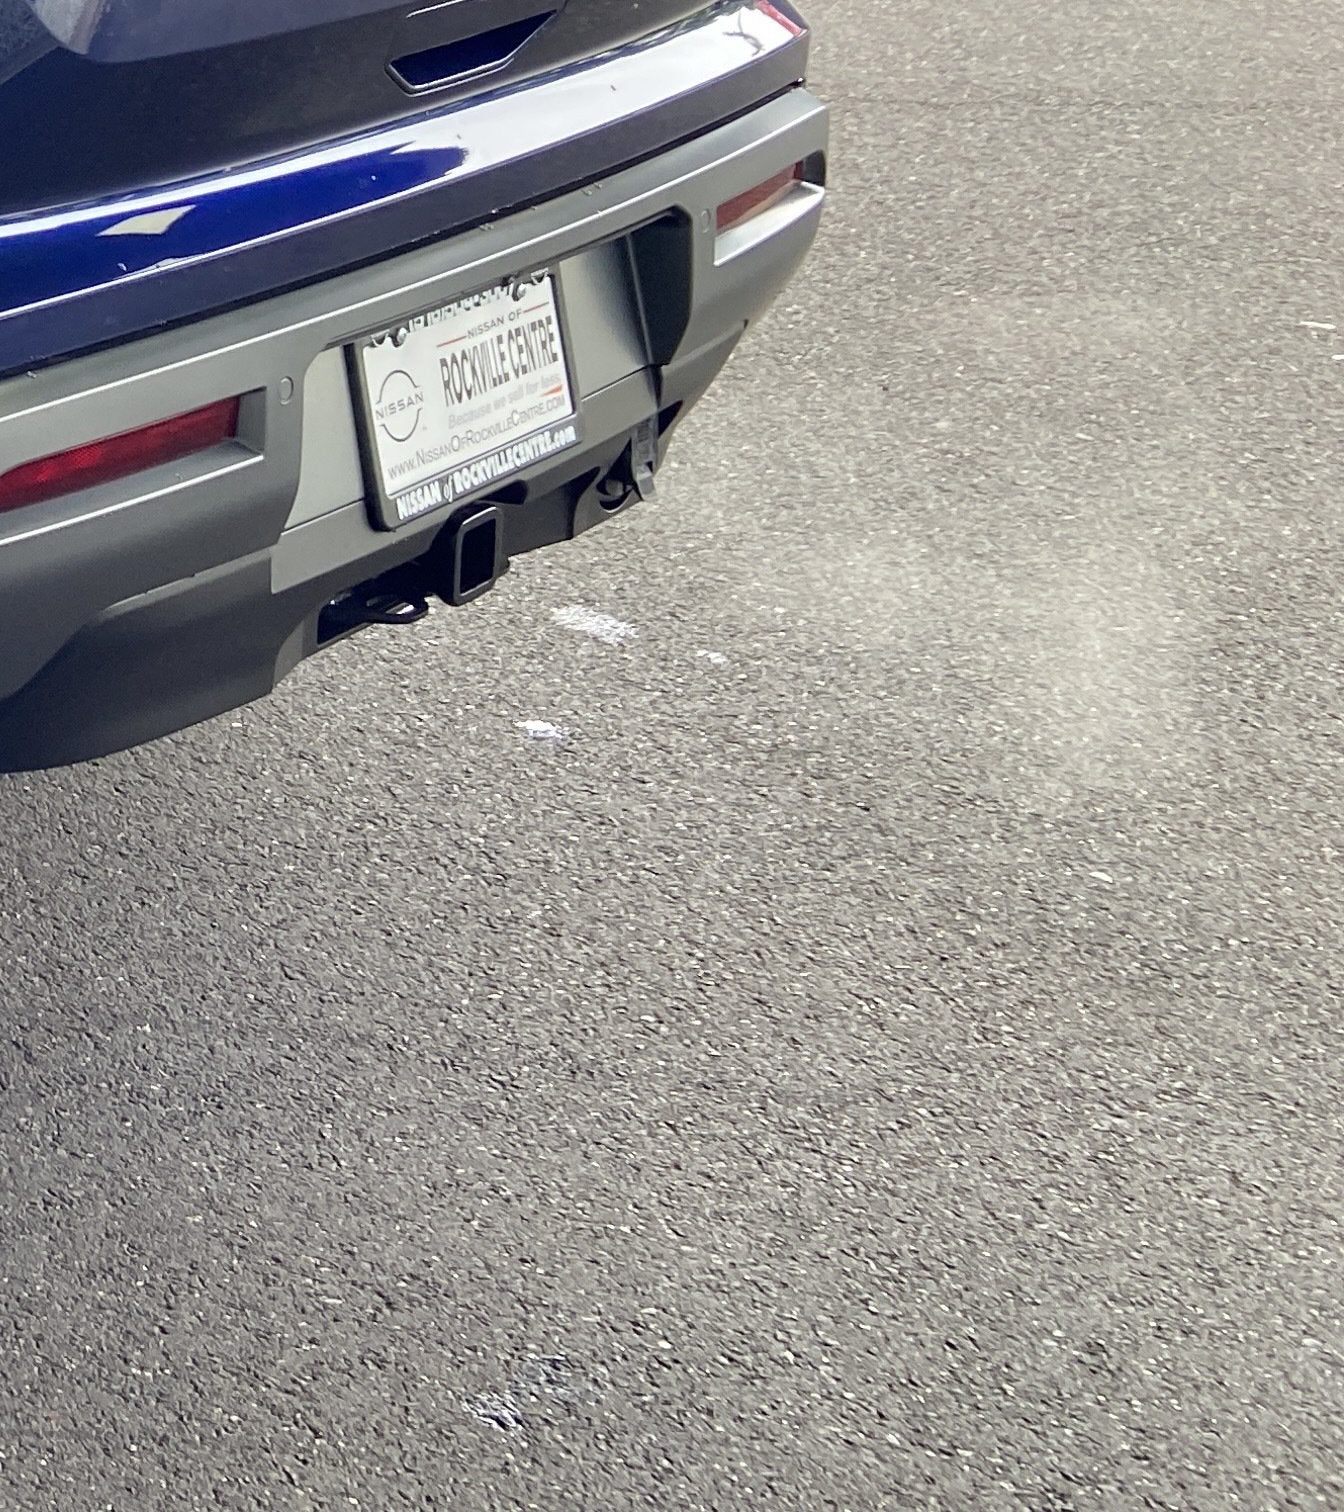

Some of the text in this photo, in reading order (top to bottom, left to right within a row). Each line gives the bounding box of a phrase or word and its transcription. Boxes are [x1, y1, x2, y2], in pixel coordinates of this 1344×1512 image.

[466, 307, 524, 339] NISSAN OF
[439, 315, 558, 407] ROCKVILLE CENTRE
[375, 391, 424, 421] NISSAN
[395, 480, 442, 521] NISSAN
